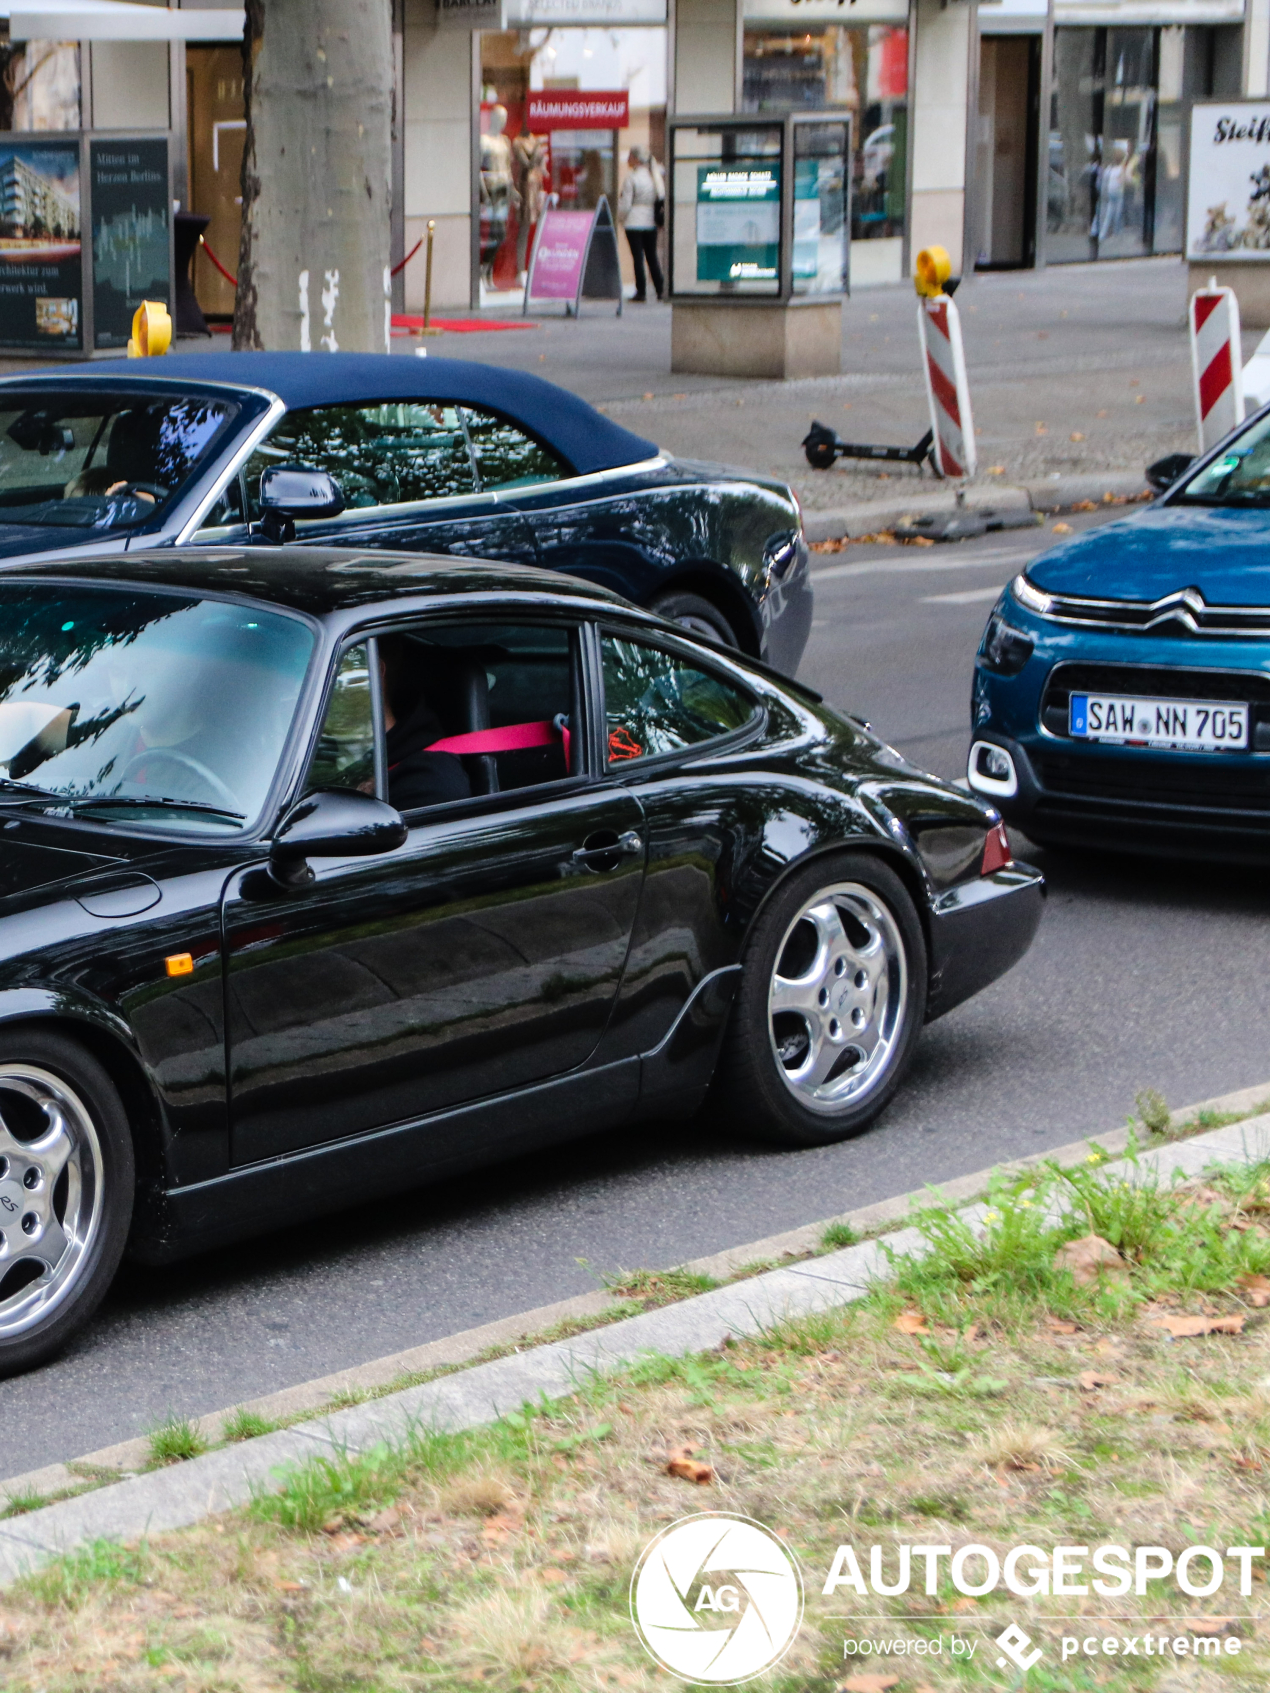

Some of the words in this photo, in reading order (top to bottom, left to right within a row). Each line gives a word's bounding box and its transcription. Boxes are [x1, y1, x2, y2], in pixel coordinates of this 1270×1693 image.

[529, 99, 627, 118] RÄUMUNGSVERKAUF
[96, 153, 126, 165] Mitten
[96, 170, 128, 184] Herzen
[1089, 702, 1135, 734] SAW
[1155, 706, 1187, 736] NN
[1195, 709, 1243, 740] 705
